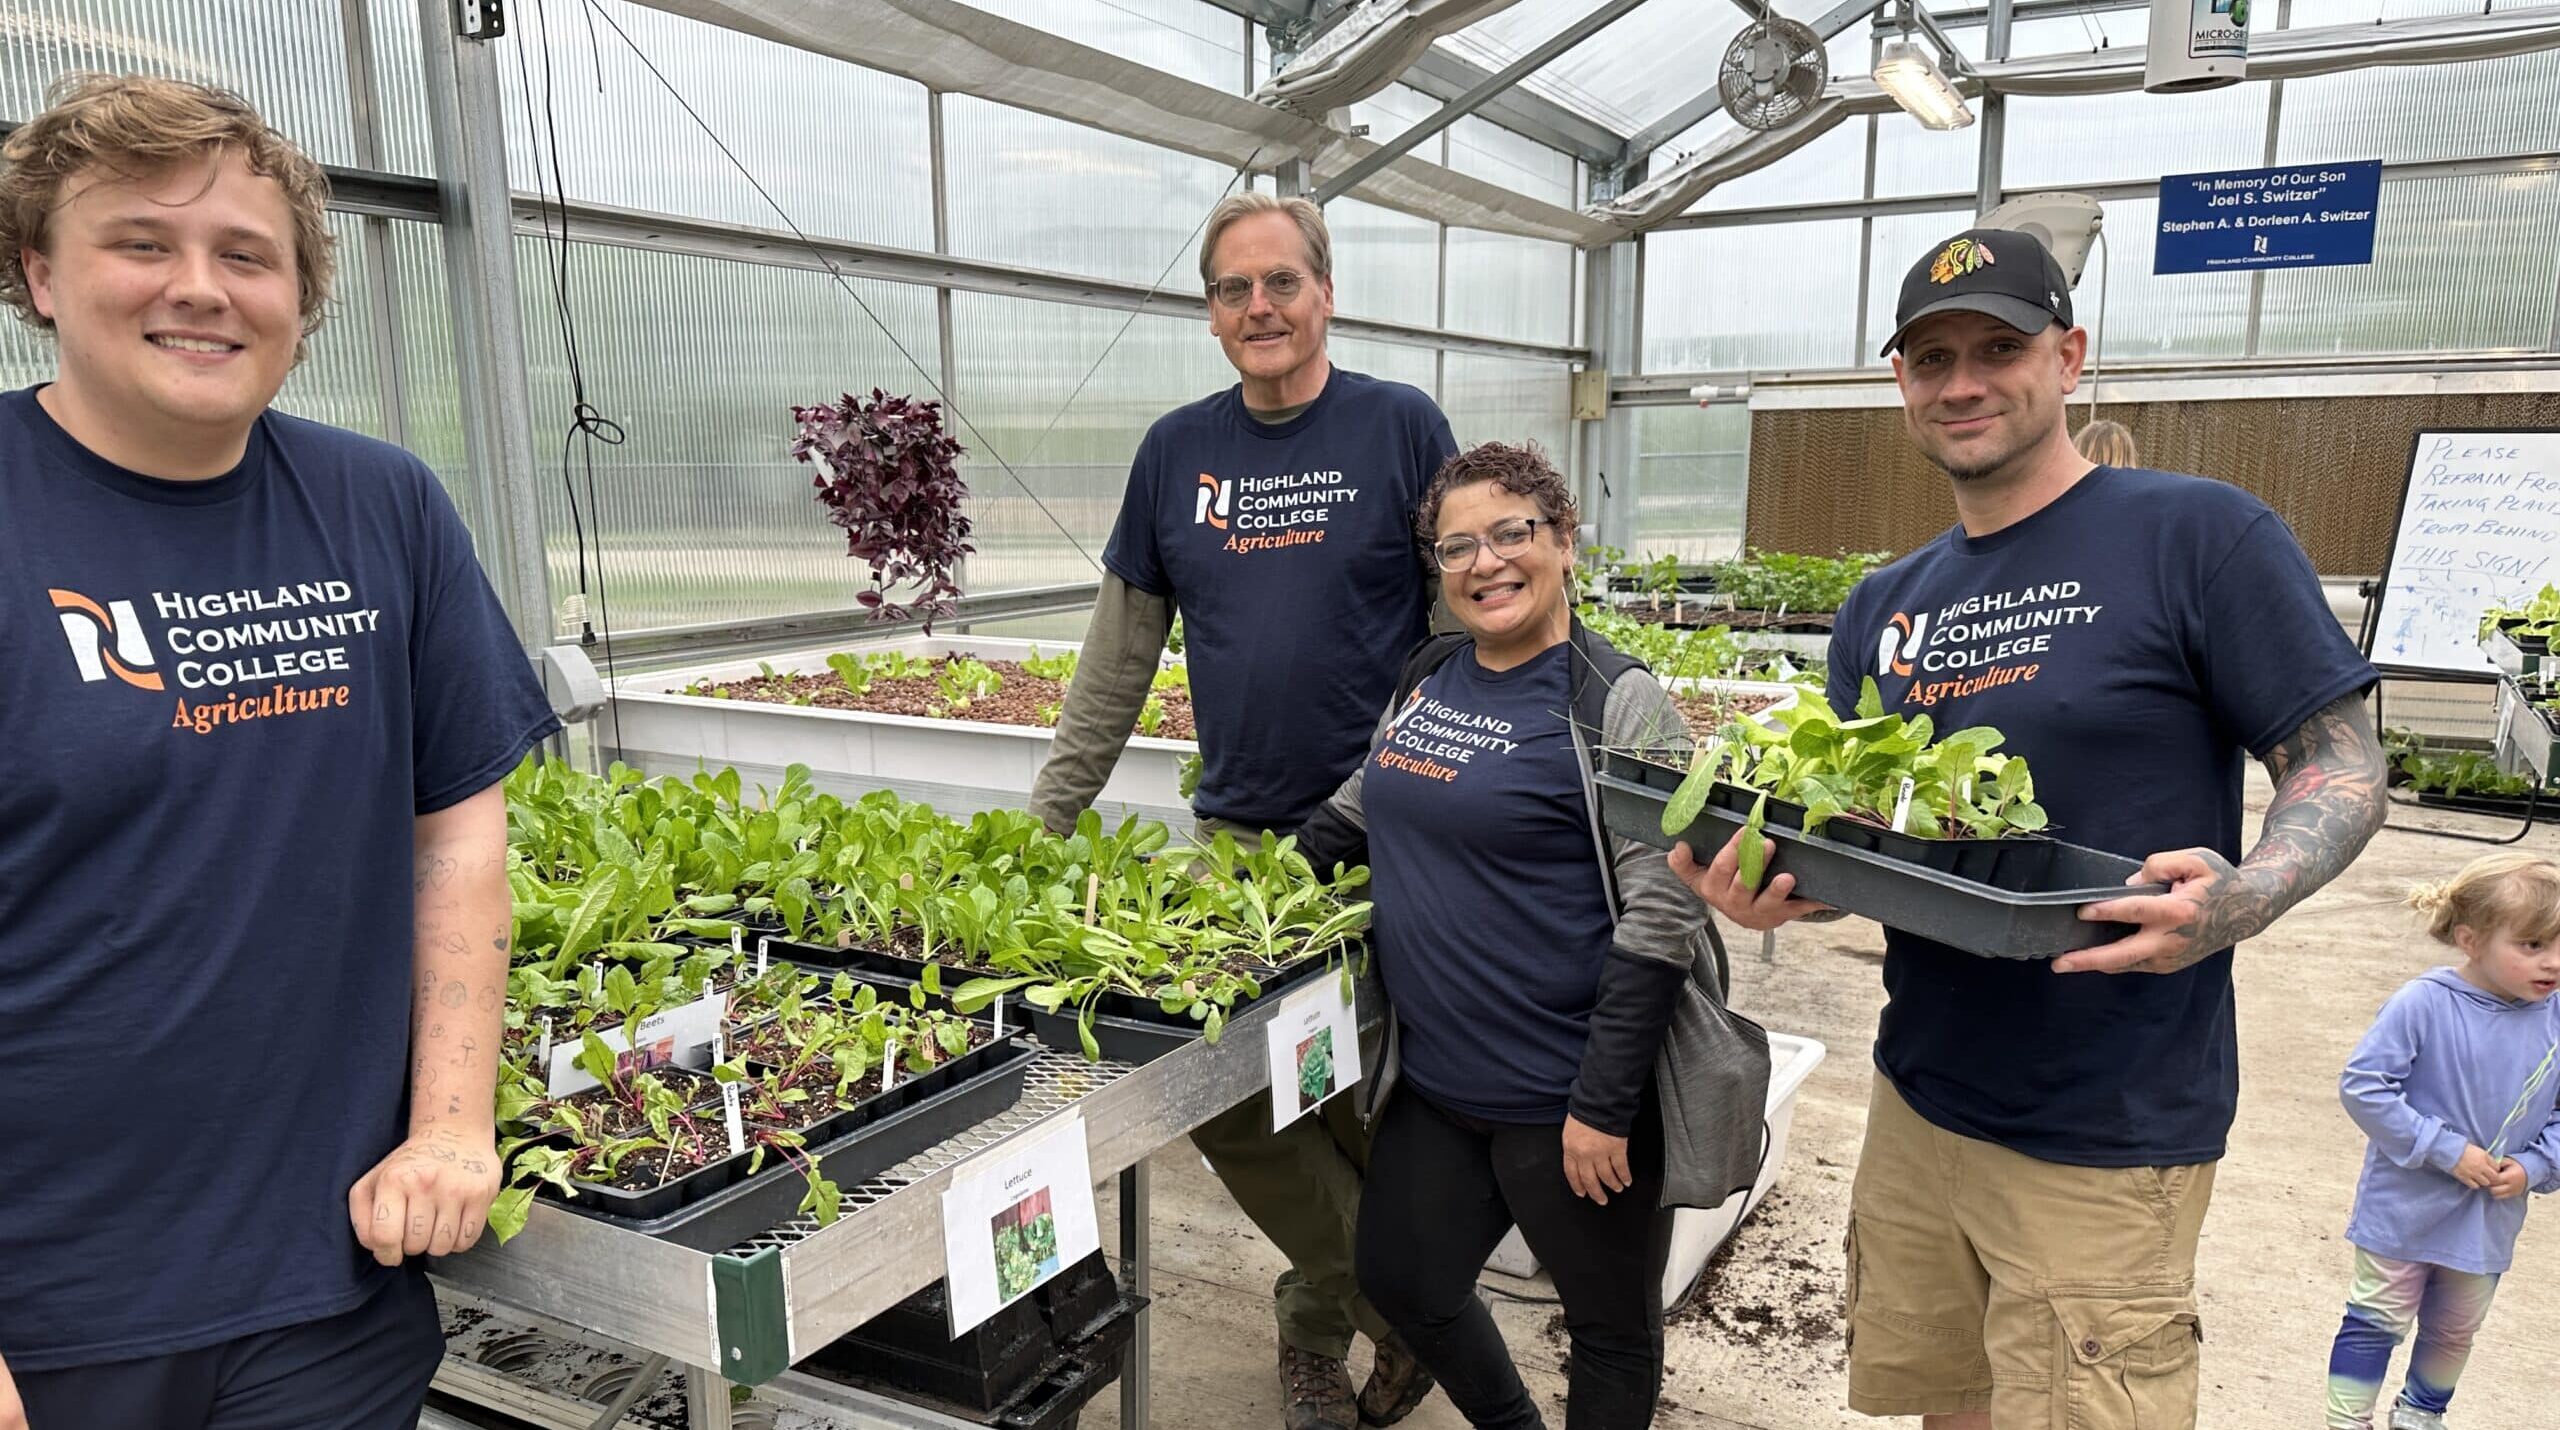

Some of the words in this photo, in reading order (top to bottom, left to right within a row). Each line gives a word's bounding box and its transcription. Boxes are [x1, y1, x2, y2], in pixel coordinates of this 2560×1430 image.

[2214, 178, 2267, 191] Memory
[2271, 174, 2288, 187] Of
[2290, 173, 2316, 185] Our
[2319, 171, 2346, 183] Son
[2207, 193, 2240, 207] Joel
[2243, 192, 2258, 204] S.
[2162, 220, 2214, 234] Stephen
[2216, 218, 2231, 230] A.
[2234, 217, 2245, 228] &
[2248, 214, 2299, 227] Dorleen
[2302, 212, 2316, 224] A.
[2320, 210, 2370, 223] Switzer
[2426, 437, 2521, 463] PLEASE
[1239, 471, 1342, 493] HIGHLAND
[2421, 464, 2511, 487] REFRAIN
[2516, 472, 2560, 493] FRO
[1238, 488, 1359, 511] COMMUNITY
[2414, 493, 2488, 513] TAKING
[1236, 508, 1329, 529] COLLEGE
[2408, 518, 2469, 536] FROM
[2474, 520, 2558, 544] BEHIND
[1223, 528, 1325, 554] Agriculture
[2403, 545, 2458, 566] THIS
[2465, 551, 2549, 584] SIGN!
[152, 580, 351, 620] HIGHLAND
[1936, 581, 2081, 627] HIGHLAND
[167, 609, 380, 655] COMMUNITY
[1929, 605, 2103, 647] COMMUNITY
[176, 647, 350, 688] COLLEGE
[1922, 634, 2052, 672] COLLEGE
[1904, 663, 2040, 706] Agriculture
[172, 683, 350, 736] Agriculture
[1421, 699, 1513, 735] HIGHLAND
[1395, 730, 1475, 764] COLLEGE
[1408, 715, 1519, 755] COMMUNITY
[1375, 746, 1458, 782] Agriculture
[640, 1016, 665, 1031] Beets
[1004, 1168, 1032, 1190] Lettuce
